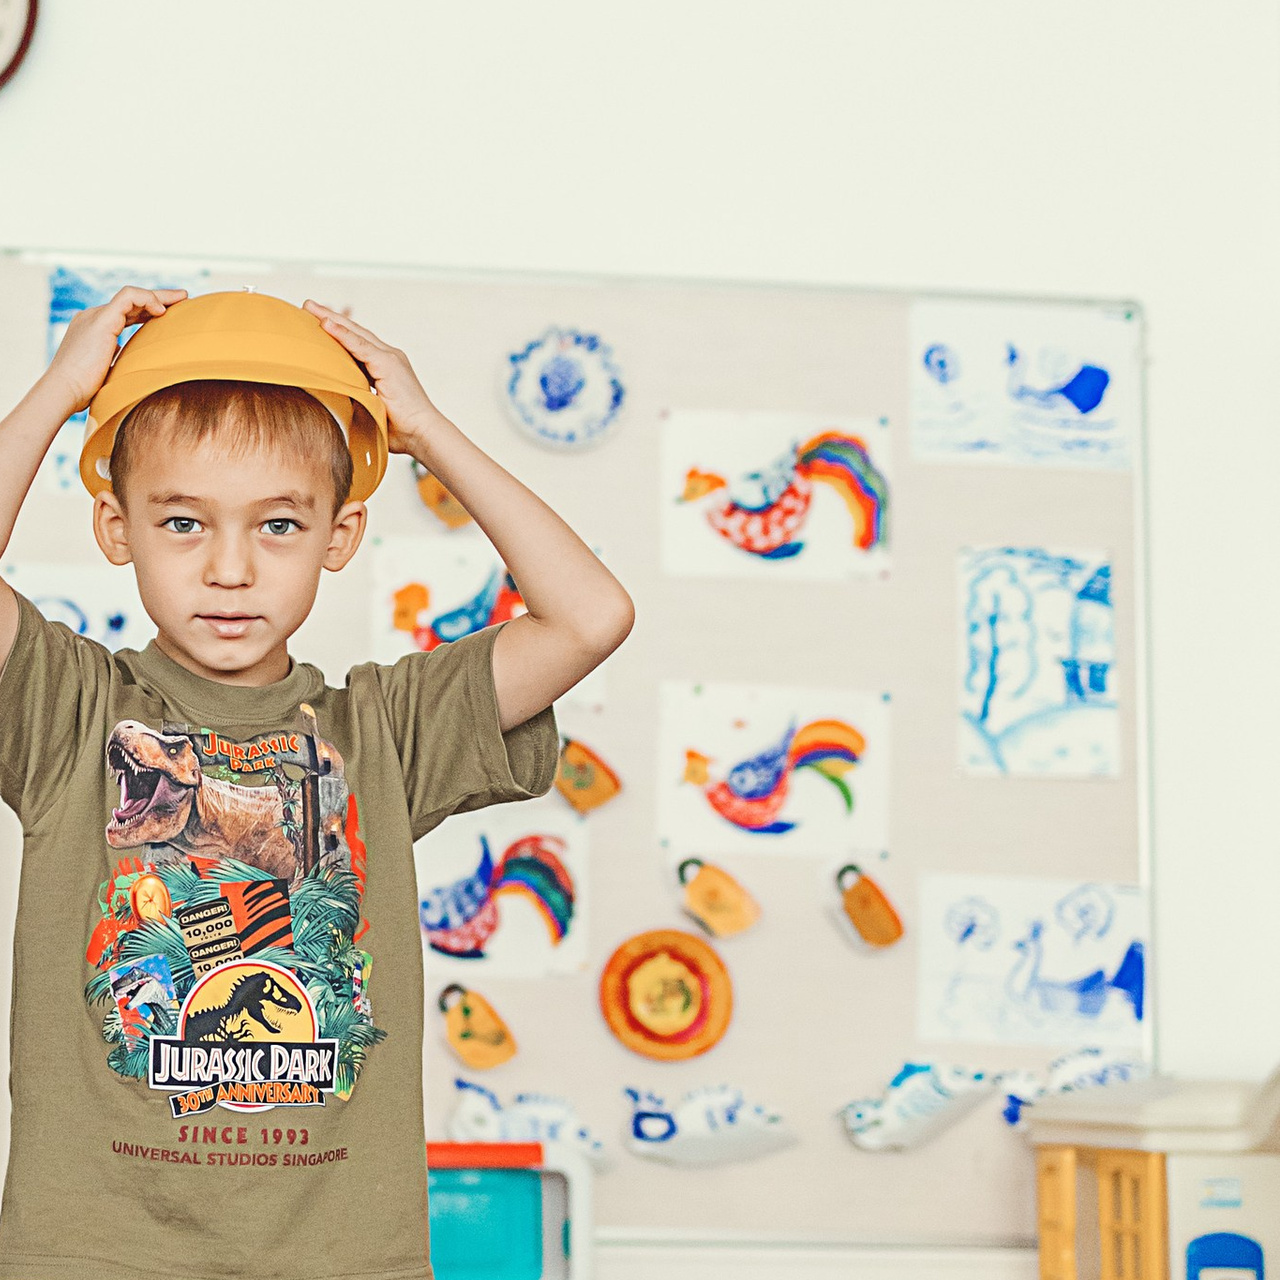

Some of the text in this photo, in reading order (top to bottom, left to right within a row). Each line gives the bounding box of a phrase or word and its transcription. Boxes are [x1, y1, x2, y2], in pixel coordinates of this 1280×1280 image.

[203, 732, 300, 760] JURASSIC
[230, 757, 276, 772] PARK
[181, 904, 228, 924] DANGER!
[186, 919, 233, 939] 10,000
[191, 939, 238, 958] DANGER!
[155, 1043, 332, 1082] JURASSIC PARK
[177, 1082, 320, 1114] 30TH ANNIVERSARY
[178, 1125, 309, 1145] SINCE 1993
[112, 1140, 349, 1167] UNIVERSAL STUDIOS SINGAPORE
